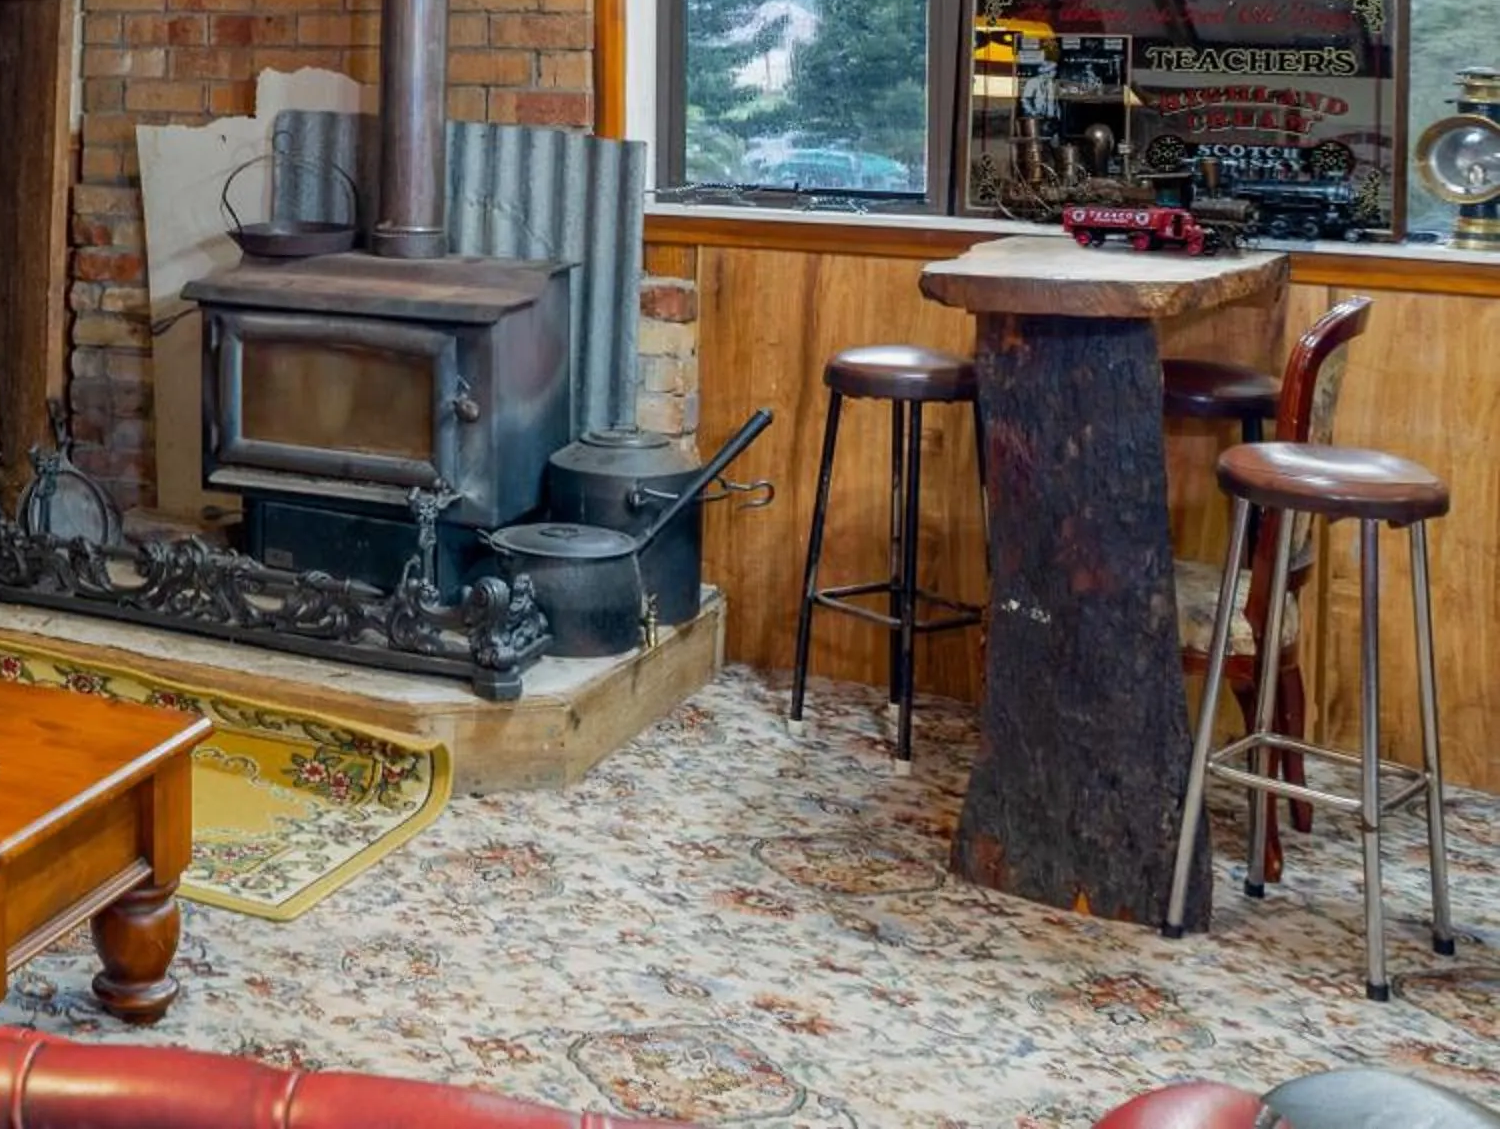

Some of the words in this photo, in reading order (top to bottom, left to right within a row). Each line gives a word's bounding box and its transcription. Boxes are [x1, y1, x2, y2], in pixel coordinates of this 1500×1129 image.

[1146, 46, 1358, 77] TEACHER'S
[1158, 84, 1349, 117] HIGHLAND
[1187, 109, 1319, 135] CREAM
[1196, 144, 1300, 158] SCOTCH
